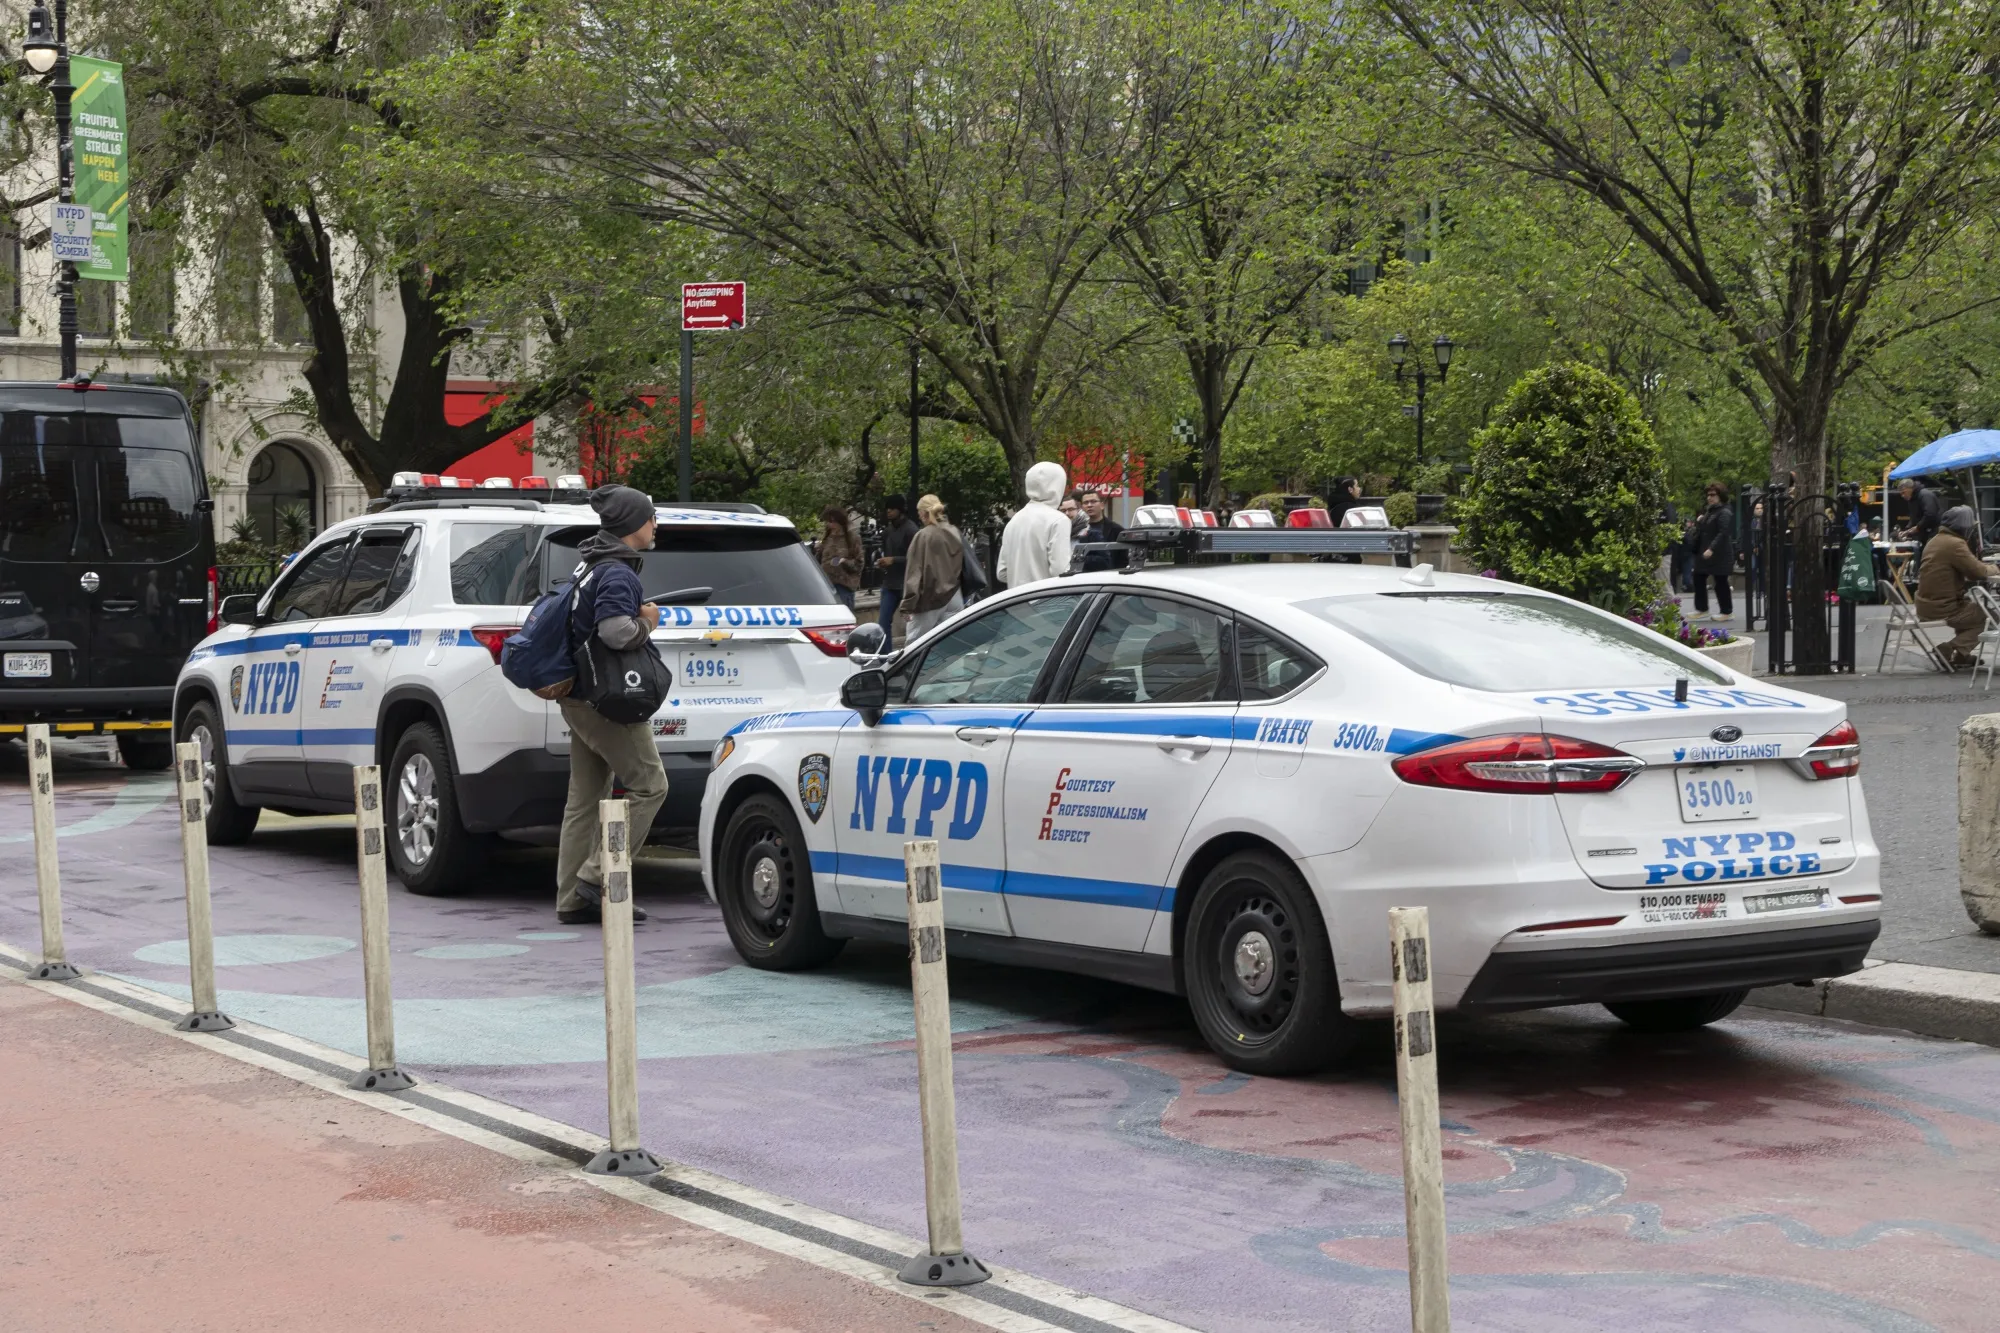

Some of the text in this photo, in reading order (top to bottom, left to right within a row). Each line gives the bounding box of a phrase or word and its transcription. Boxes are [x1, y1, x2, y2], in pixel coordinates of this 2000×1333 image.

[80, 112, 119, 129] FRUITFUL
[74, 126, 124, 142] GREENMARKET
[85, 140, 122, 155] STROLLS
[82, 154, 115, 169] HAPPEN
[97, 169, 119, 183] HERE
[57, 207, 85, 220] NYPD
[53, 233, 91, 246] SECURITY
[55, 244, 89, 257] CAMERA
[686, 288, 697, 298] NO
[686, 299, 717, 309] Anytime
[659, 607, 803, 626] PD POLICE
[244, 661, 300, 714] NYPD
[683, 697, 764, 706] @NYPDTRANSIT
[653, 718, 687, 726] REWARD
[1259, 717, 1313, 745] TBATU
[1690, 743, 1782, 760] @NYPDTRANSIT
[1055, 768, 1116, 793] COURTESY
[850, 755, 988, 840] NYPD
[1046, 792, 1148, 821] PROFESSIONALISM
[1038, 817, 1091, 843] RESPECT
[1662, 831, 1796, 859] NYPD
[1644, 853, 1821, 885] POLICE
[1640, 893, 1726, 908] $10,000 REWARD
[1644, 913, 1661, 923] CALL
